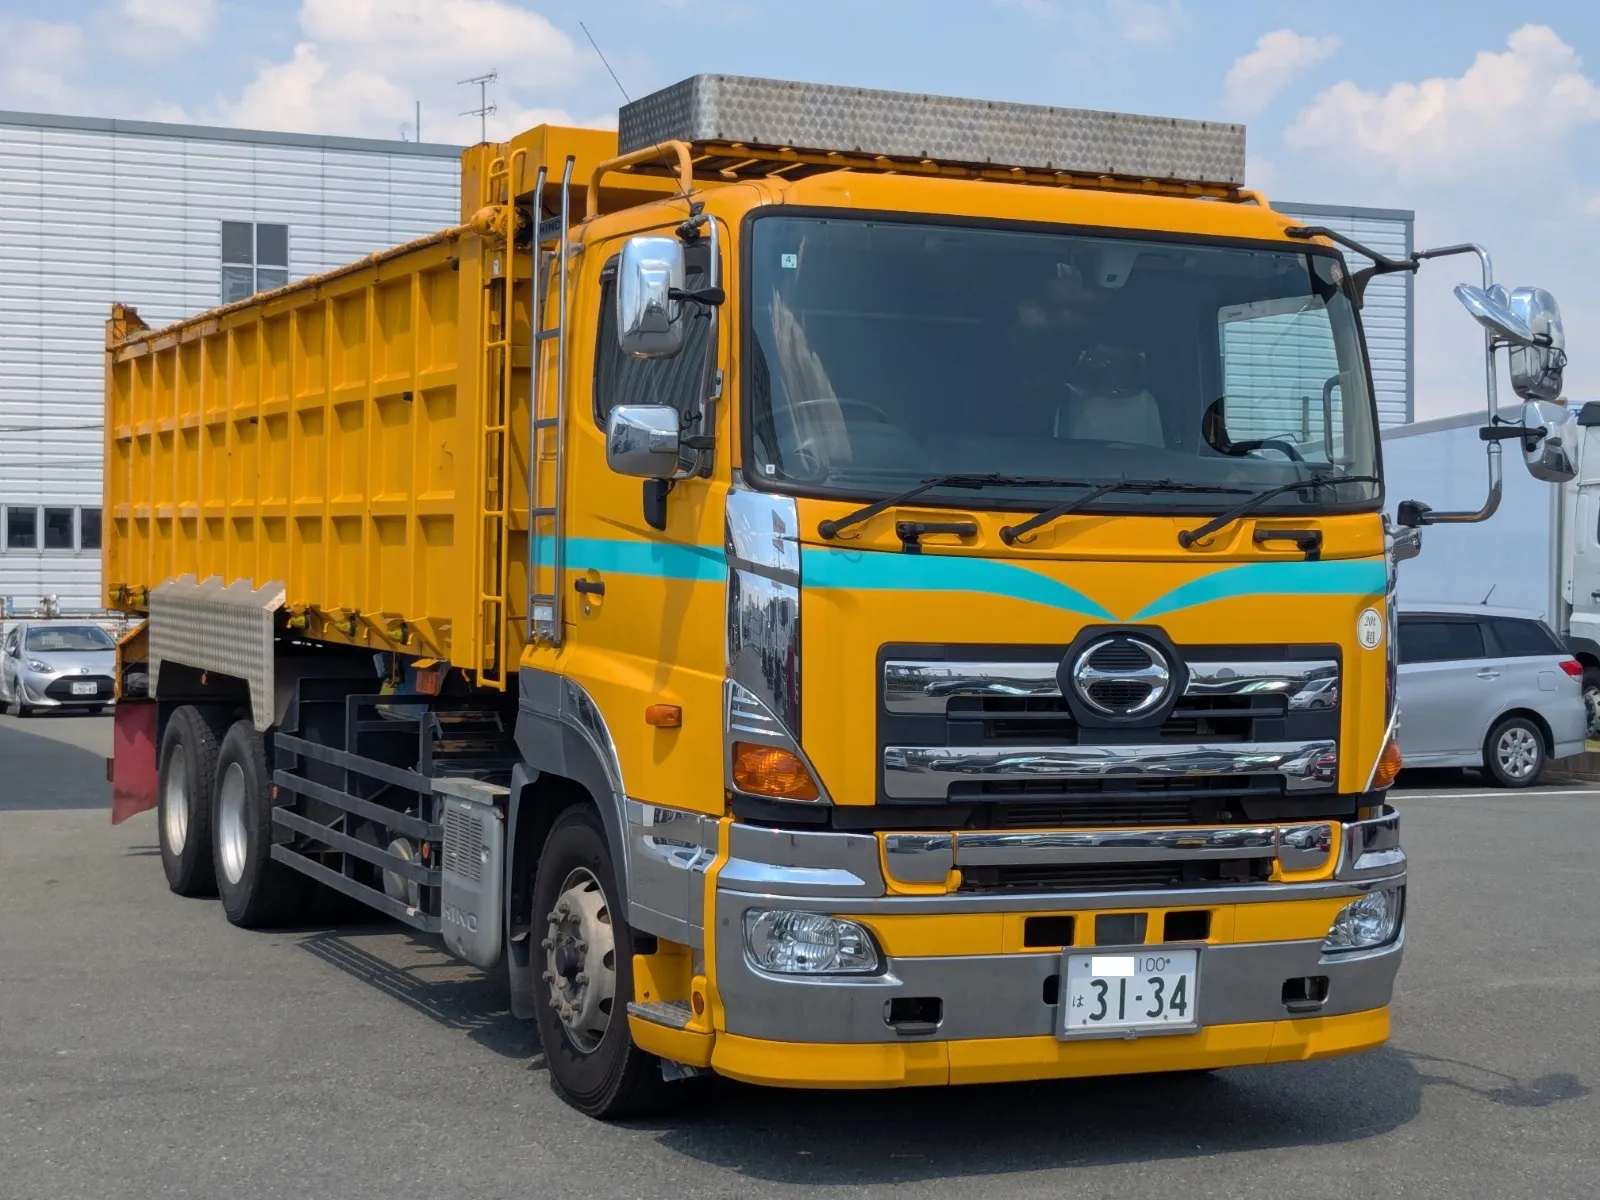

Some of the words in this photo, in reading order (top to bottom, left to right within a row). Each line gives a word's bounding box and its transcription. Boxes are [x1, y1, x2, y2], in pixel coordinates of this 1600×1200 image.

[539, 219, 561, 235] HINO
[1363, 615, 1377, 627] 20t
[1139, 956, 1166, 973] 100
[1072, 994, 1084, 1008] は
[1088, 974, 1188, 1021] 31-34
